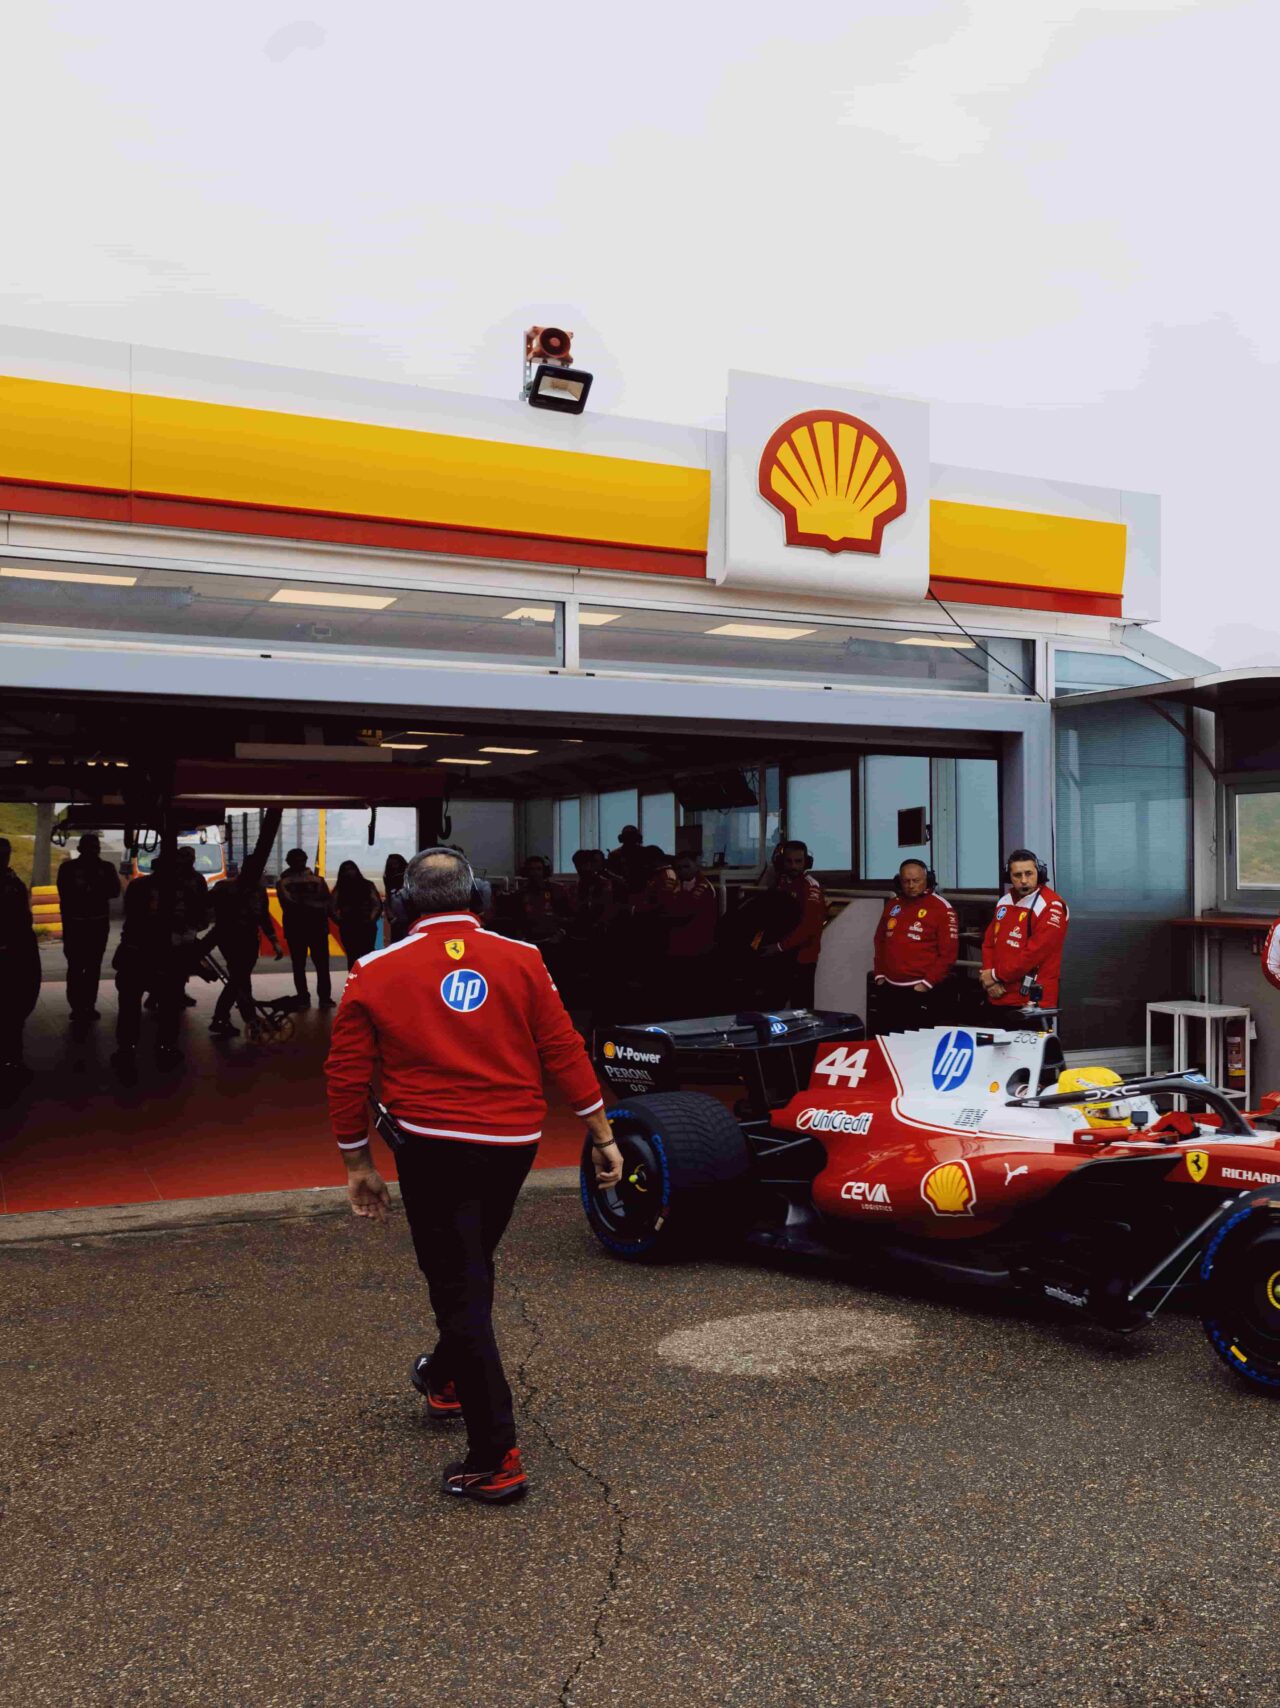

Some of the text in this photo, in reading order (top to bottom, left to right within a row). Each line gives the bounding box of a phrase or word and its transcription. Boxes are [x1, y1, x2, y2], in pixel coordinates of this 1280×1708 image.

[449, 971, 481, 1011] hp
[615, 1046, 661, 1064] V-Power
[934, 1030, 972, 1092] hp
[604, 1065, 652, 1081] PERONI
[815, 1046, 870, 1088] 44
[811, 1109, 872, 1134] UniCredit
[1221, 1167, 1280, 1184] RICHARD
[861, 1203, 893, 1212] LOGISTICS
